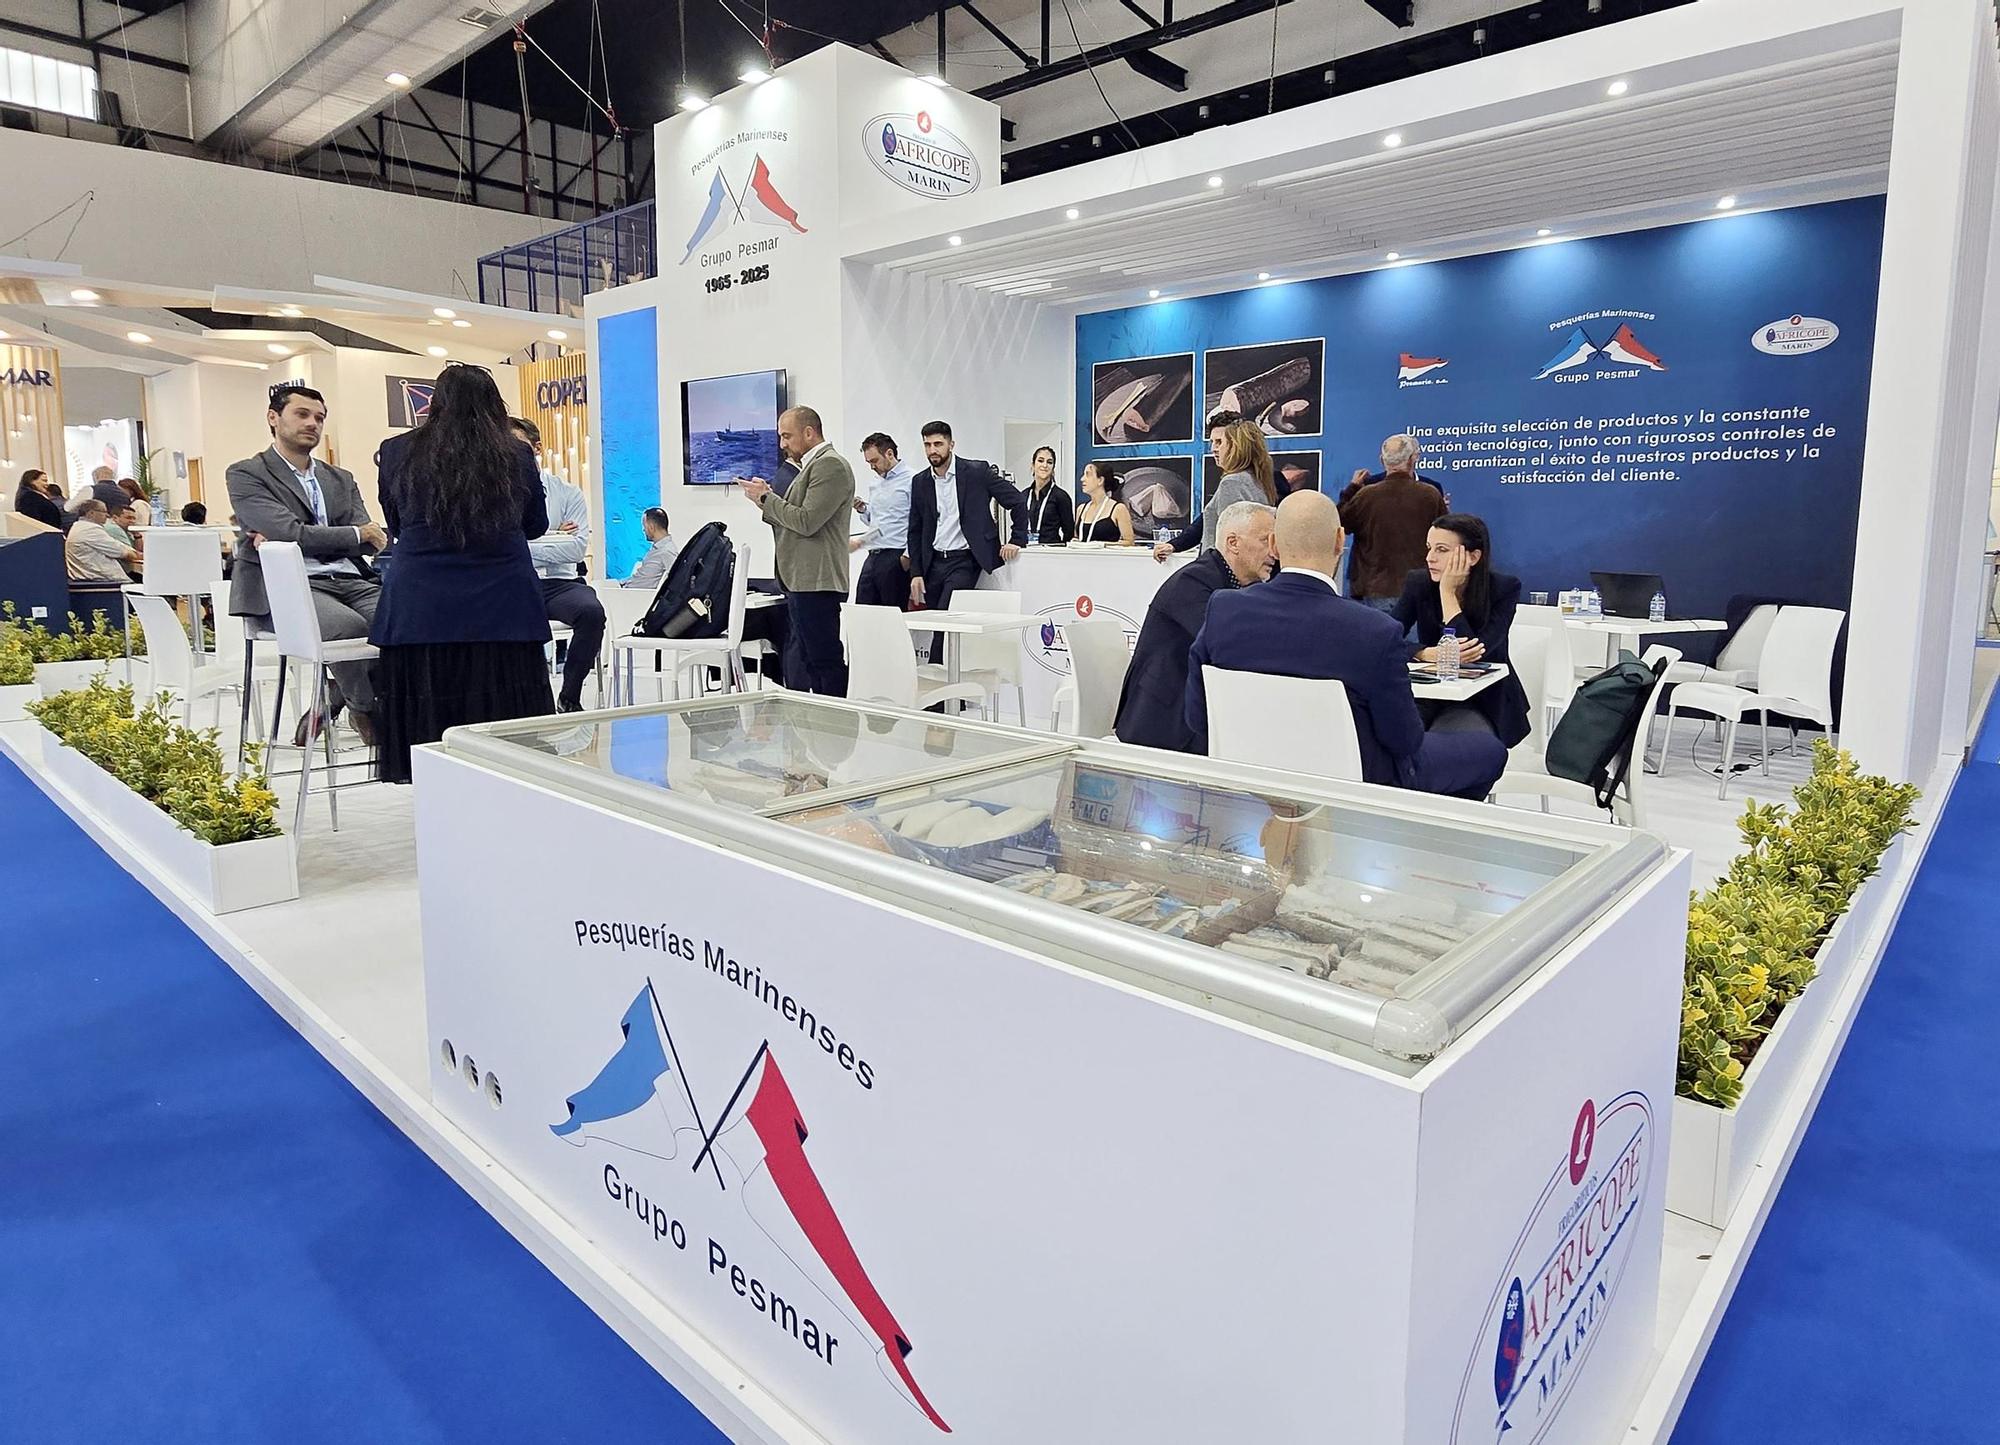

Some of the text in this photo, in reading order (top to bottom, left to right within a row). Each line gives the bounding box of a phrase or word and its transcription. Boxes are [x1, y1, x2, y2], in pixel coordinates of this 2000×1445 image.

[737, 128, 788, 142] Marinenses
[908, 170, 950, 192] MARIN
[701, 236, 779, 268] Grupo Pesmar
[705, 274, 731, 293] 1965
[740, 264, 769, 285] 2025
[1601, 309, 1655, 320] Marinenses
[1554, 369, 1640, 384] Grupo Pesmar
[1407, 406, 1811, 437] Una exquisita selección de productos y la constante
[1418, 423, 1836, 453] vación tecnológica, junto con rigurosos controles de
[1452, 454, 1526, 471] garantizan
[1531, 453, 1545, 466] el
[1550, 452, 1586, 465] éxito
[1591, 451, 1610, 464] de
[1616, 451, 1686, 464] nuestros
[1692, 446, 1779, 464] productos
[1785, 448, 1796, 462] y
[1802, 444, 1820, 458] la
[1500, 467, 1681, 484] satisfacción del cliente.
[574, 919, 876, 1091] Pesquerías Marinenses
[603, 1164, 839, 1366] Grupo Pesmar
